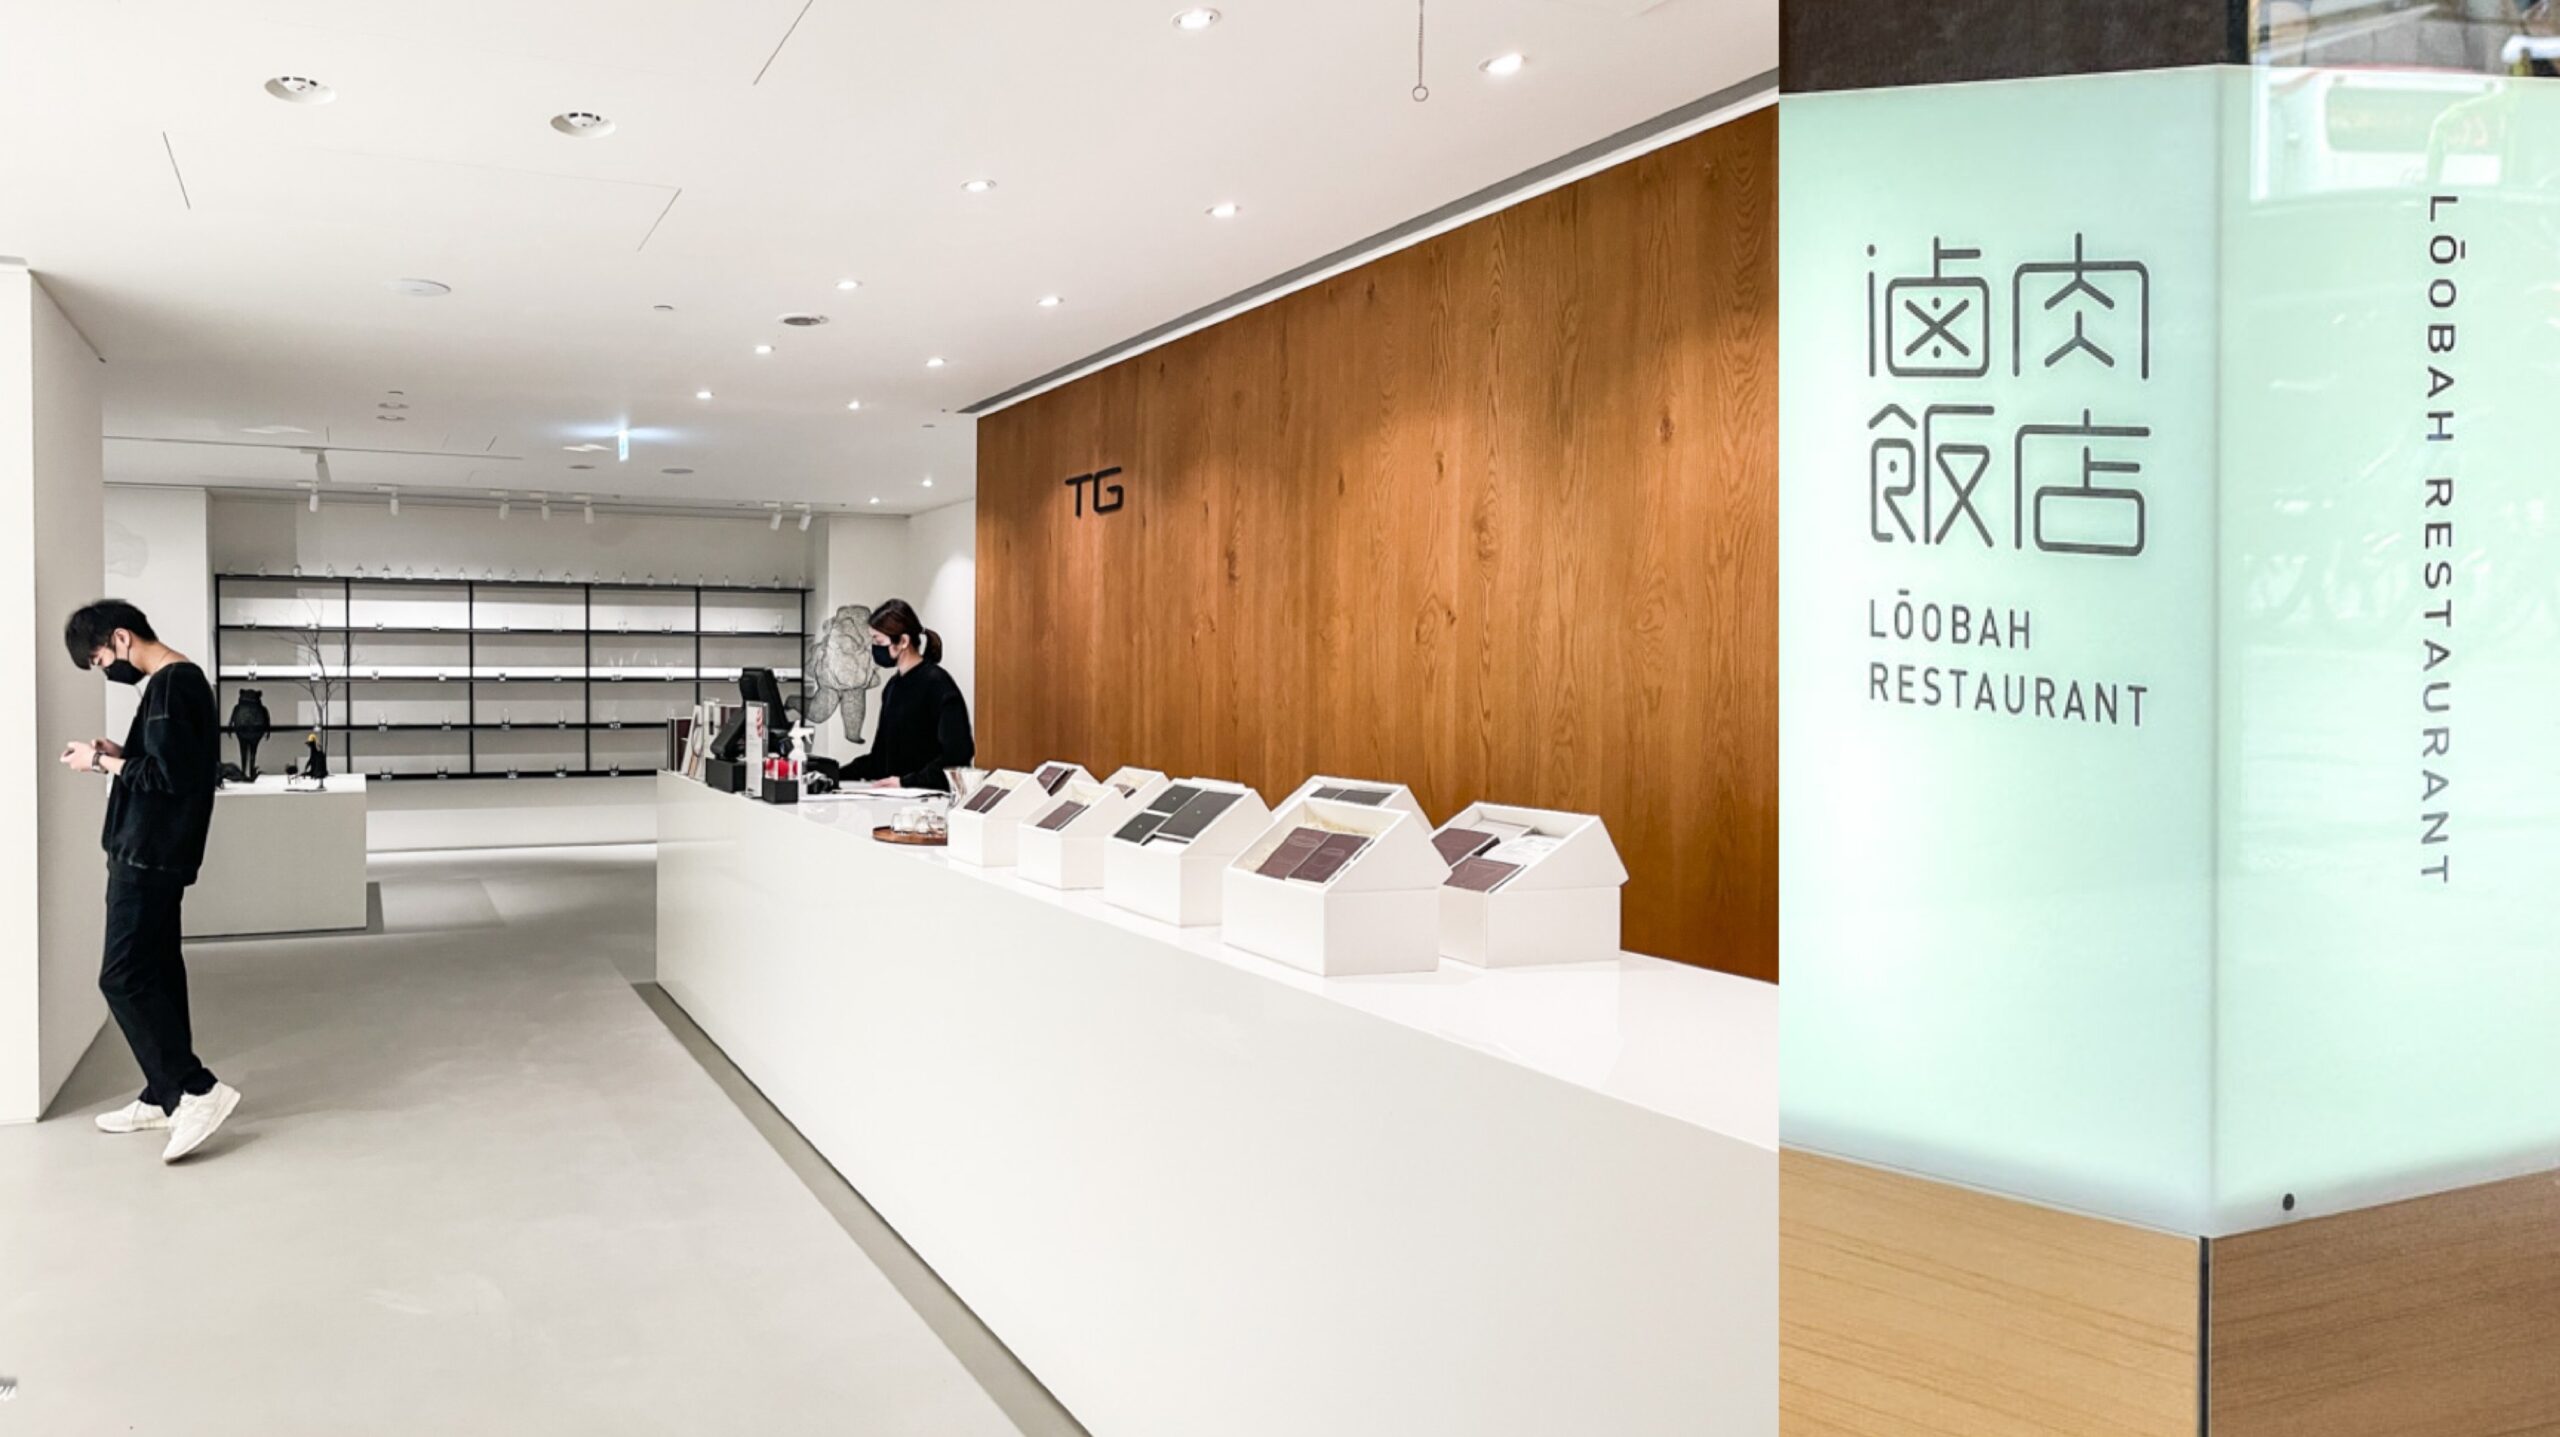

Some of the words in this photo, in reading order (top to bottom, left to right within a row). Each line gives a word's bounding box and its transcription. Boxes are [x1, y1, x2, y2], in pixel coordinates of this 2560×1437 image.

[2428, 195, 2466, 442] LŌOBAH
[1065, 467, 1124, 518] TG
[1867, 403, 2151, 557] 飯店
[1870, 589, 2031, 650] LŌOBAH
[1870, 662, 2148, 728] RESTAURANT
[2420, 478, 2454, 884] RESTAURANT
